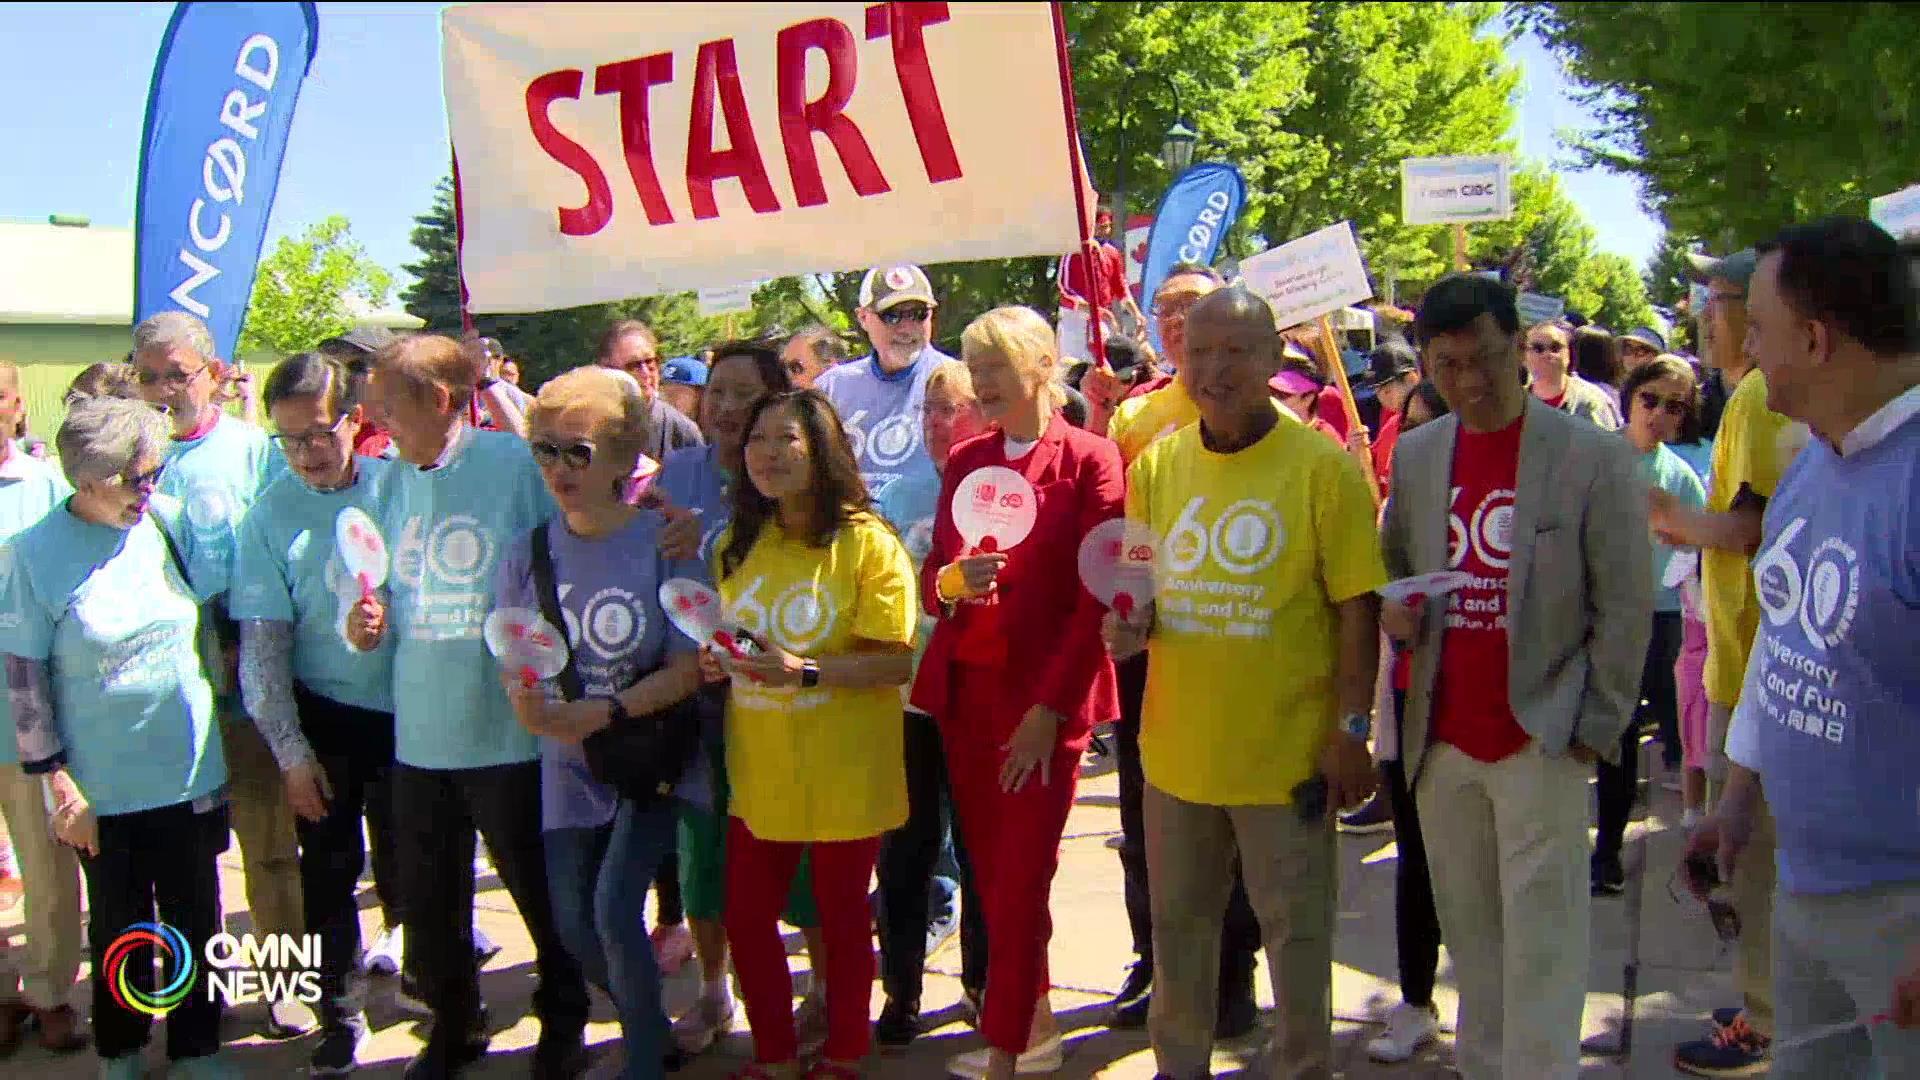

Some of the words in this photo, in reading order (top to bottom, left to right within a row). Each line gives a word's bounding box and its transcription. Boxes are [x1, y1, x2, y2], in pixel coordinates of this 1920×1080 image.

[526, 2, 963, 237] START
[1464, 595, 1500, 613] and
[1767, 672, 1803, 704] and
[1804, 684, 1847, 719] Fun
